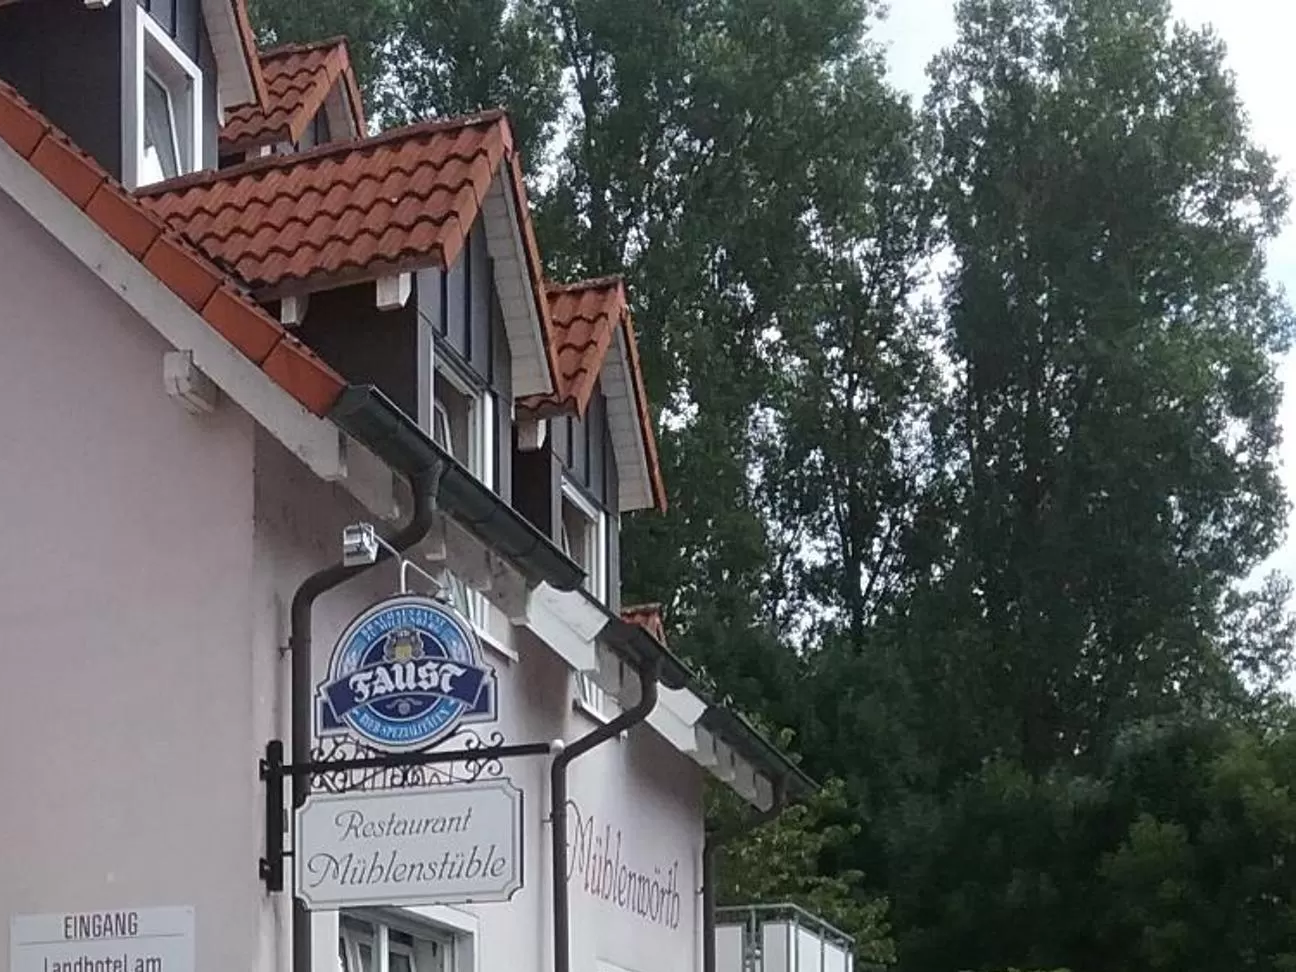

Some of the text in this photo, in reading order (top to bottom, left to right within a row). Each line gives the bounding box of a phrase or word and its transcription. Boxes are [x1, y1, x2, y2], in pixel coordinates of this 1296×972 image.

[349, 661, 467, 702] FAUST
[335, 807, 473, 842] Restaurant
[307, 845, 506, 888] Mühlenstüble
[64, 912, 138, 940] EINGANG
